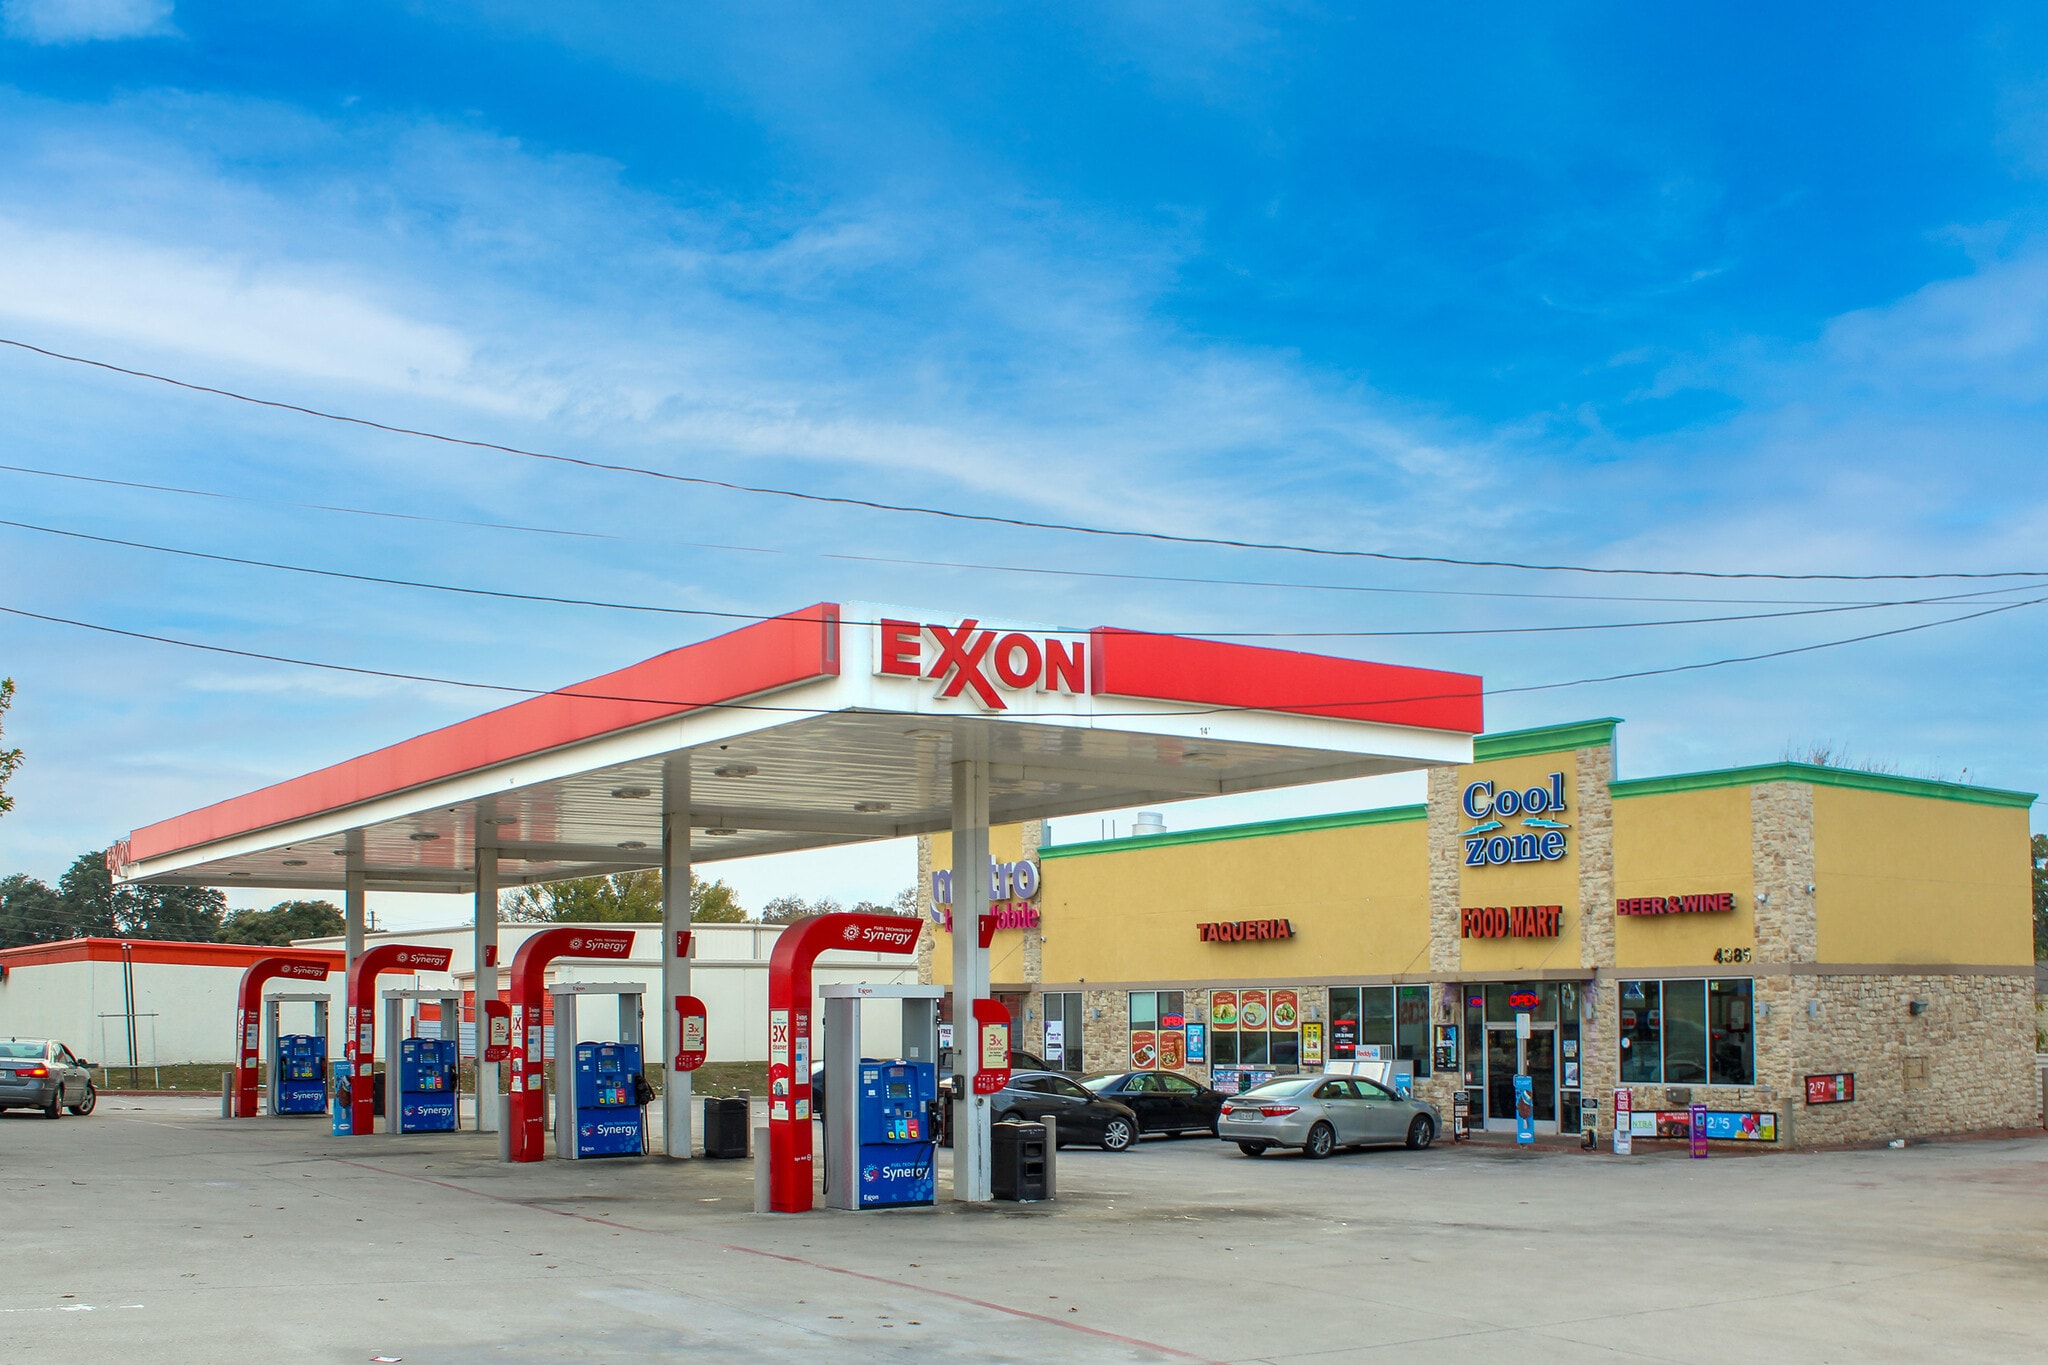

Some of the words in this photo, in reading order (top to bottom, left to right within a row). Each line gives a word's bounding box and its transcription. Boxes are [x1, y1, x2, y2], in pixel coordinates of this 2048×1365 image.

[878, 618, 1085, 711] EXXON
[1462, 772, 1565, 819] Cool
[1464, 831, 1565, 867] zone
[932, 854, 1040, 904] mtro
[1617, 897, 1665, 915] BEER
[1681, 893, 1732, 912] WINE
[1197, 919, 1291, 942] TAQUERIA
[1461, 907, 1509, 938] FOOD
[1510, 906, 1562, 938] MART
[862, 928, 912, 945] Synergy
[585, 940, 627, 952] Synergy
[410, 954, 446, 966] Synergy
[1713, 947, 1752, 964] 4385
[292, 965, 325, 977] Synergy
[1508, 994, 1539, 1007] OPEN
[688, 1023, 699, 1033] 3x
[773, 1024, 788, 1043] 3X
[989, 1033, 1003, 1046] 3x
[292, 1091, 324, 1101] Synergy
[417, 1106, 453, 1116] Synergy
[597, 1124, 638, 1137] Synergy
